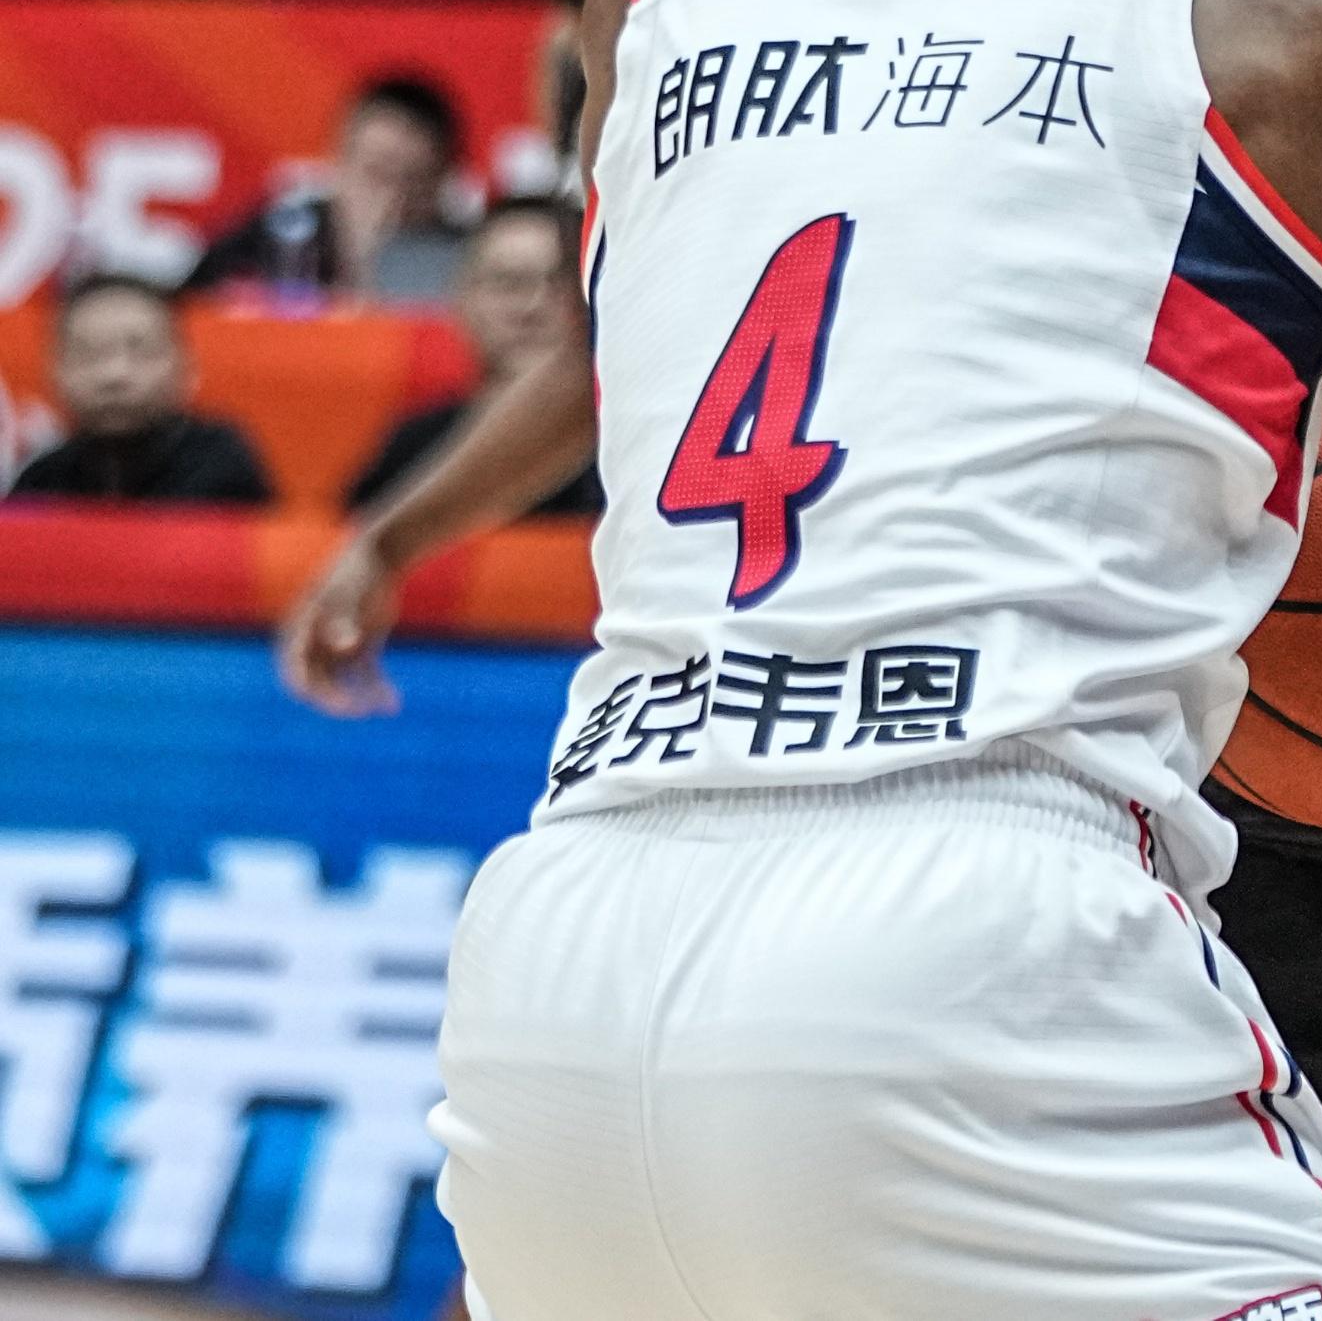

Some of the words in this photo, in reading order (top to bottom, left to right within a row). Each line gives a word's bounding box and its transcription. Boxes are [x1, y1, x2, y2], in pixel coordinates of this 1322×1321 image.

[654, 32, 1115, 181] 朗肽海本
[657, 212, 856, 611] 4
